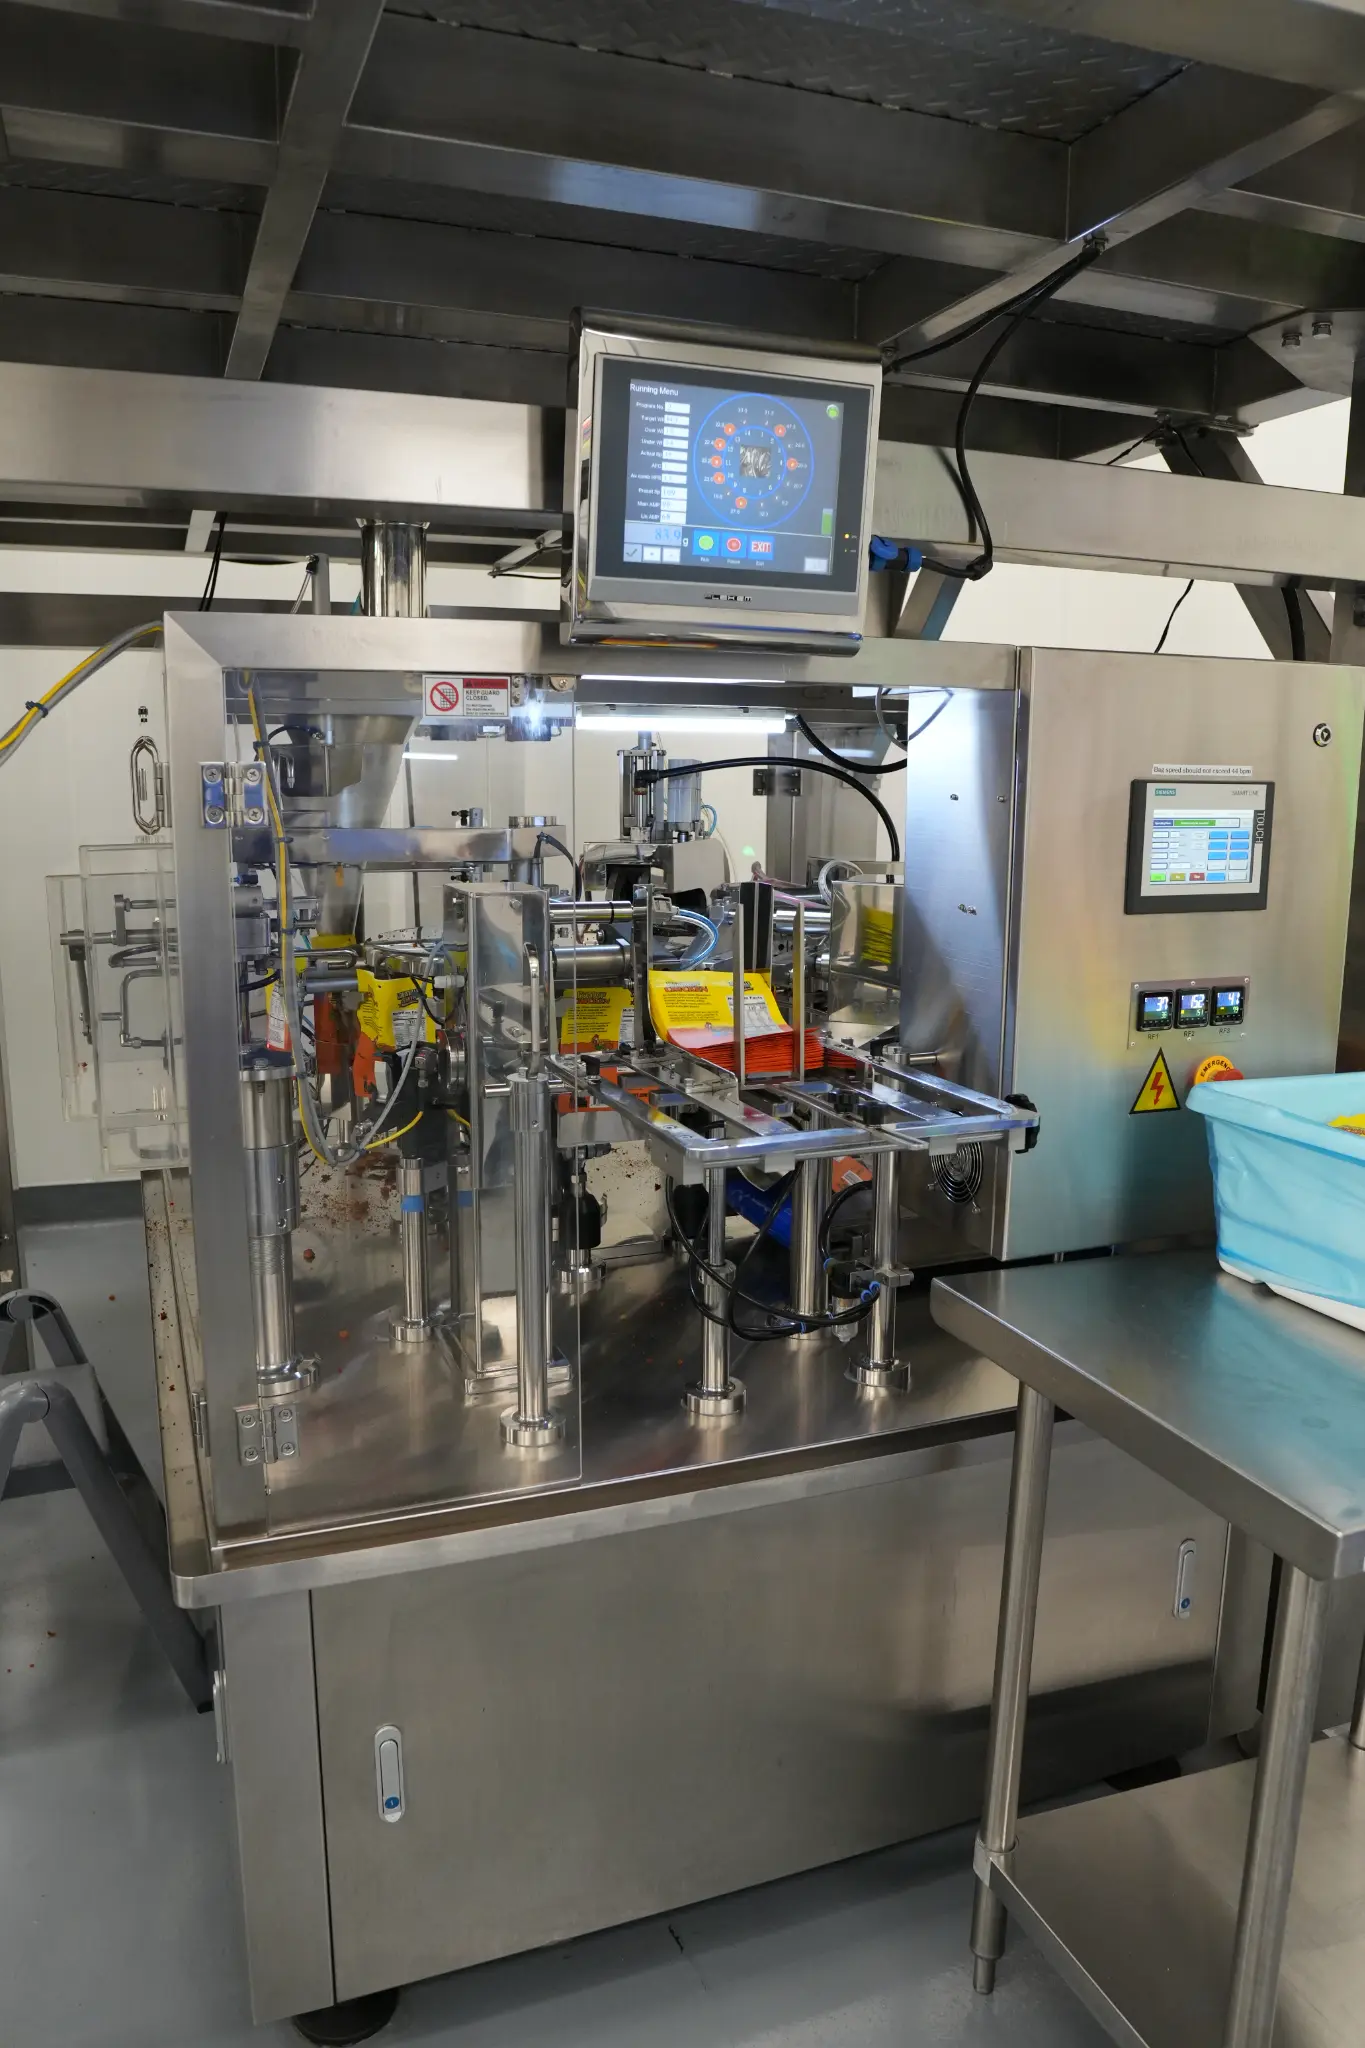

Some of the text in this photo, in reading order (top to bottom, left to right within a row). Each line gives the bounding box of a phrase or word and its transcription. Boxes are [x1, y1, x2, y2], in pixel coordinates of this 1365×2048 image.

[630, 383, 679, 396] Running Menu
[641, 414, 657, 423] Target
[682, 538, 689, 547] g
[751, 541, 772, 553] EXIT
[1153, 766, 1165, 774] Bag
[1256, 811, 1265, 844] TOUCH
[1200, 1060, 1231, 1078] EMERGENC
